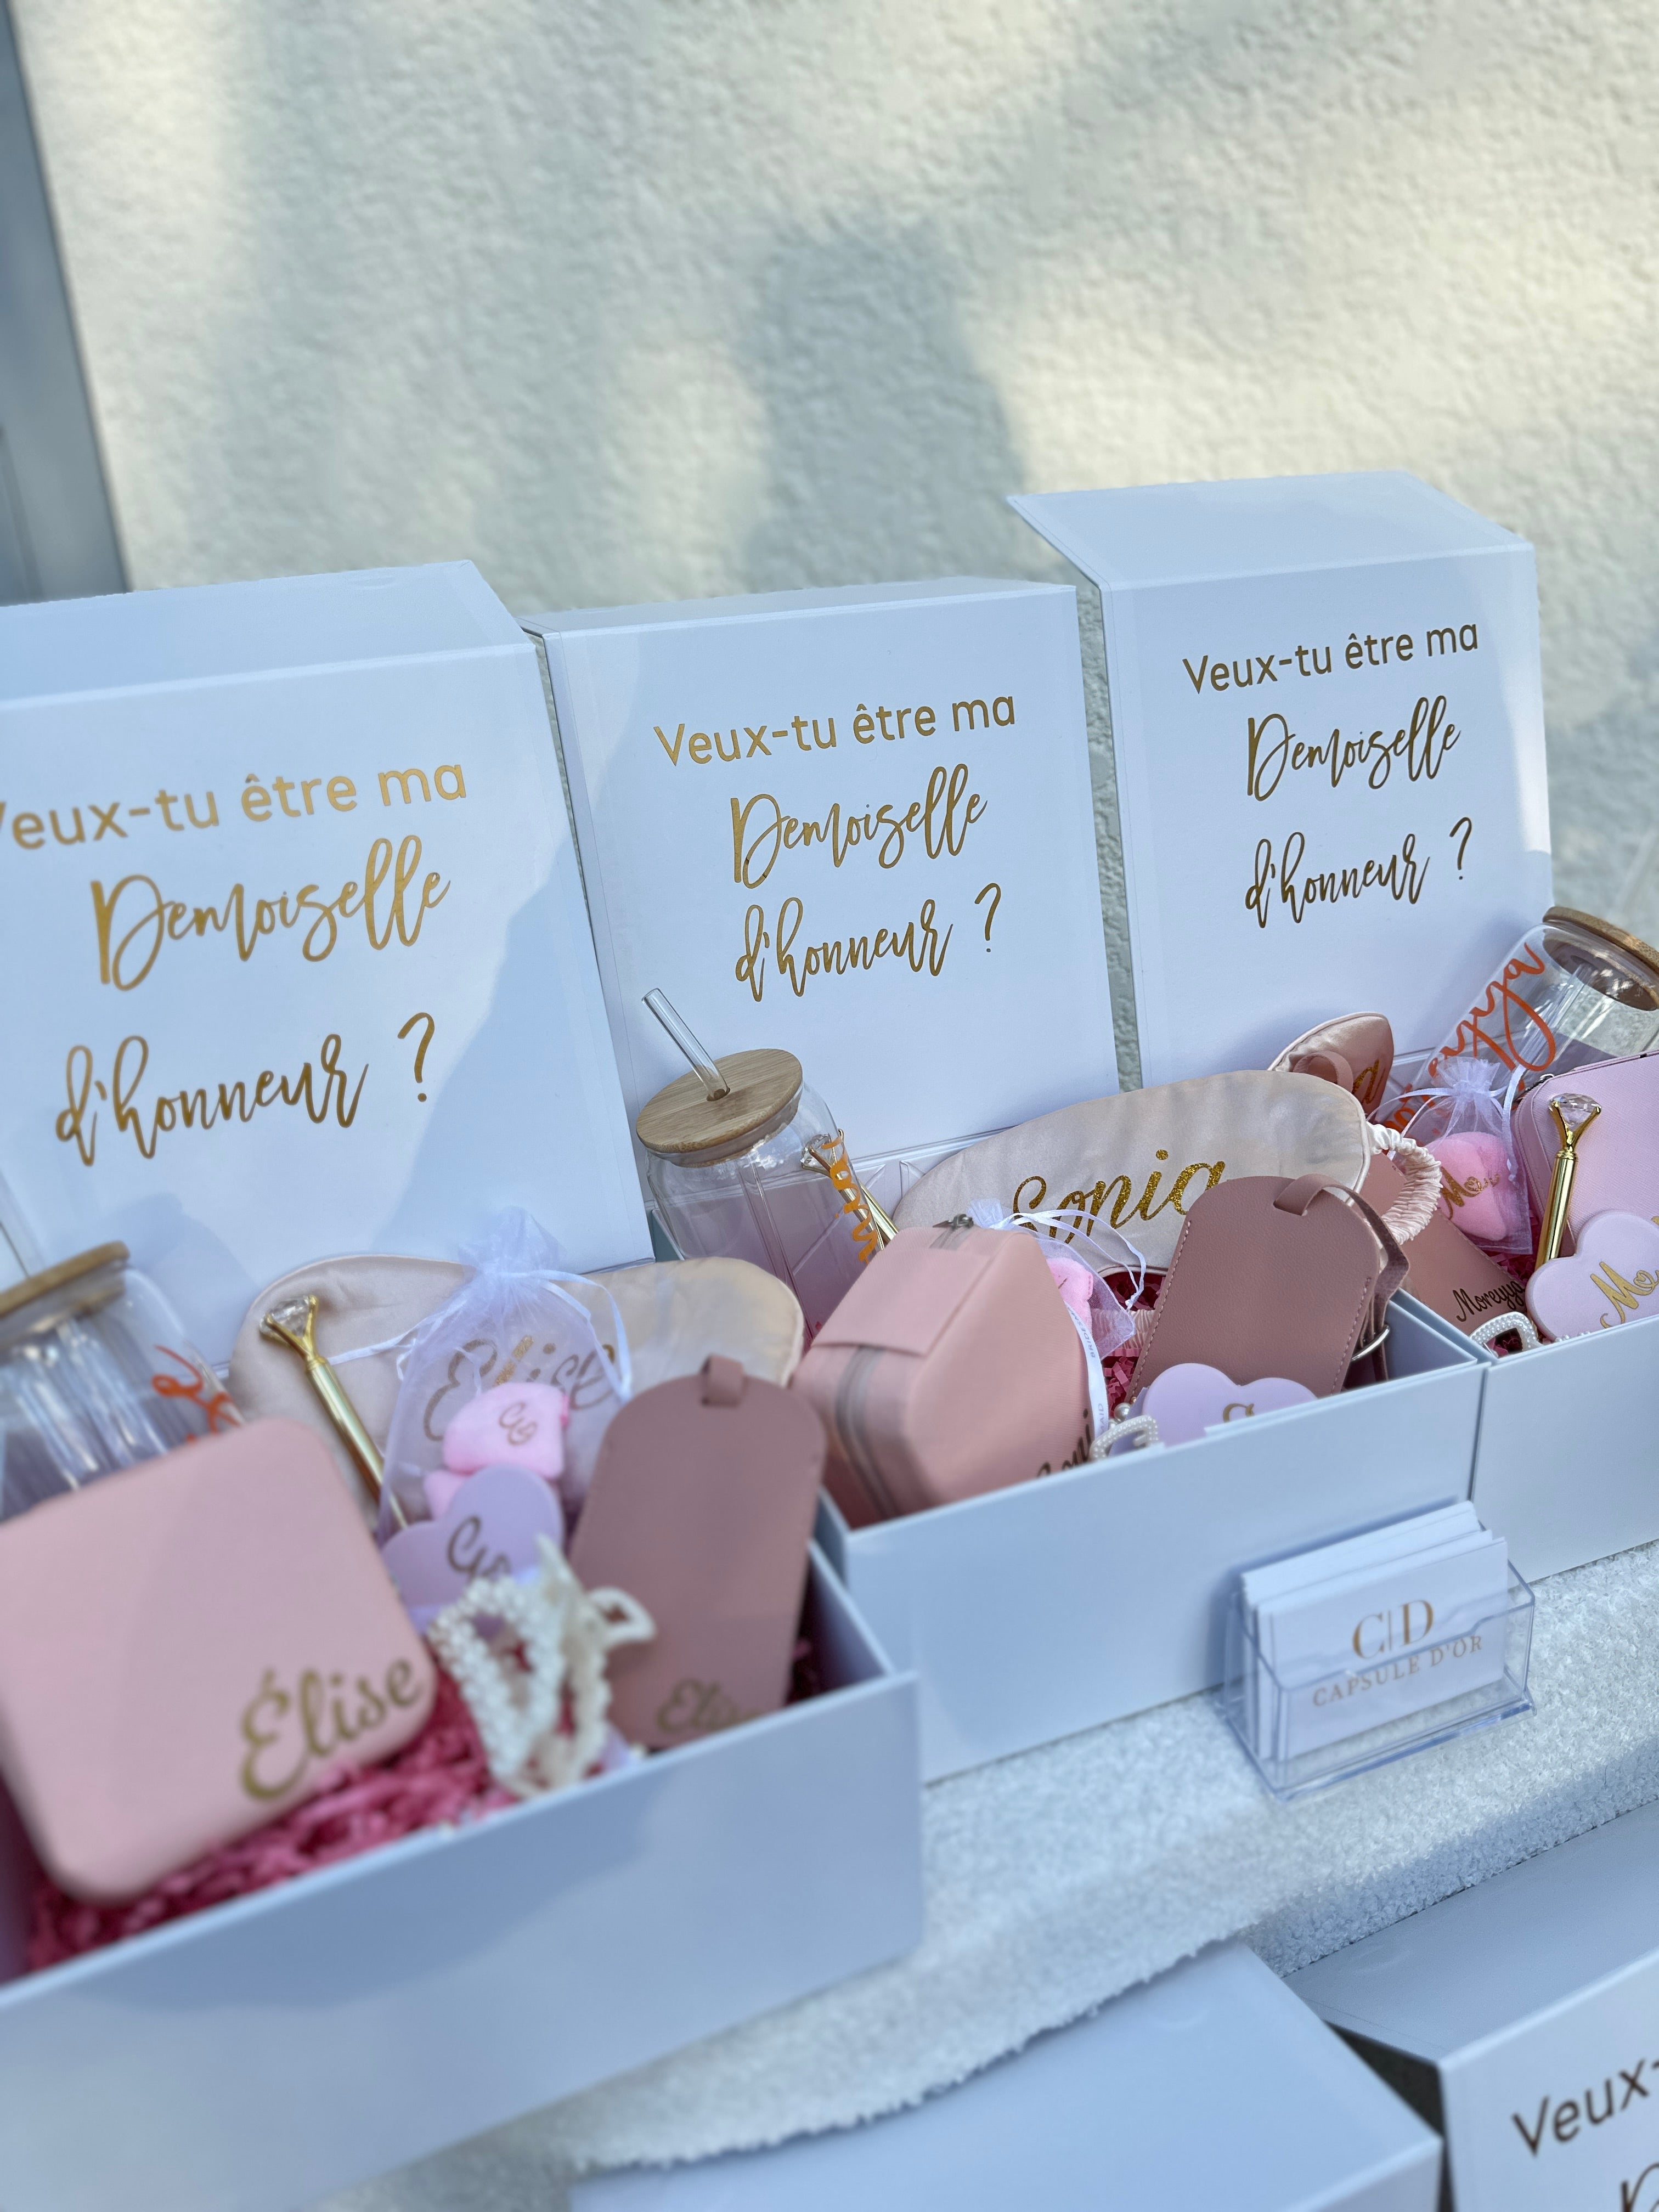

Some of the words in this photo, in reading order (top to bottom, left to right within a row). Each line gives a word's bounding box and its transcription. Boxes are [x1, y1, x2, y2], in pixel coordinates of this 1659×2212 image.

[1182, 645, 1331, 694] Veux-tu
[1345, 633, 1413, 670] être
[1426, 624, 1479, 657] ma
[653, 715, 837, 766] Veux-tu
[853, 703, 936, 744] être
[952, 696, 1015, 732] ma
[1247, 695, 1462, 801] Demoiselle
[241, 774, 357, 822] être
[378, 765, 466, 806] ma
[730, 764, 988, 889] Demoiselle
[91, 835, 451, 991] Demoiselle
[1245, 832, 1430, 928] d'honneur
[736, 898, 953, 1002] d'honneur
[56, 1034, 369, 1166] d'honneur
[1452, 1280, 1525, 1322] Moreyya
[1312, 1654, 1420, 1707] CAPSULE
[1430, 1634, 1483, 1668] D'OR
[240, 1657, 424, 1801] Élise
